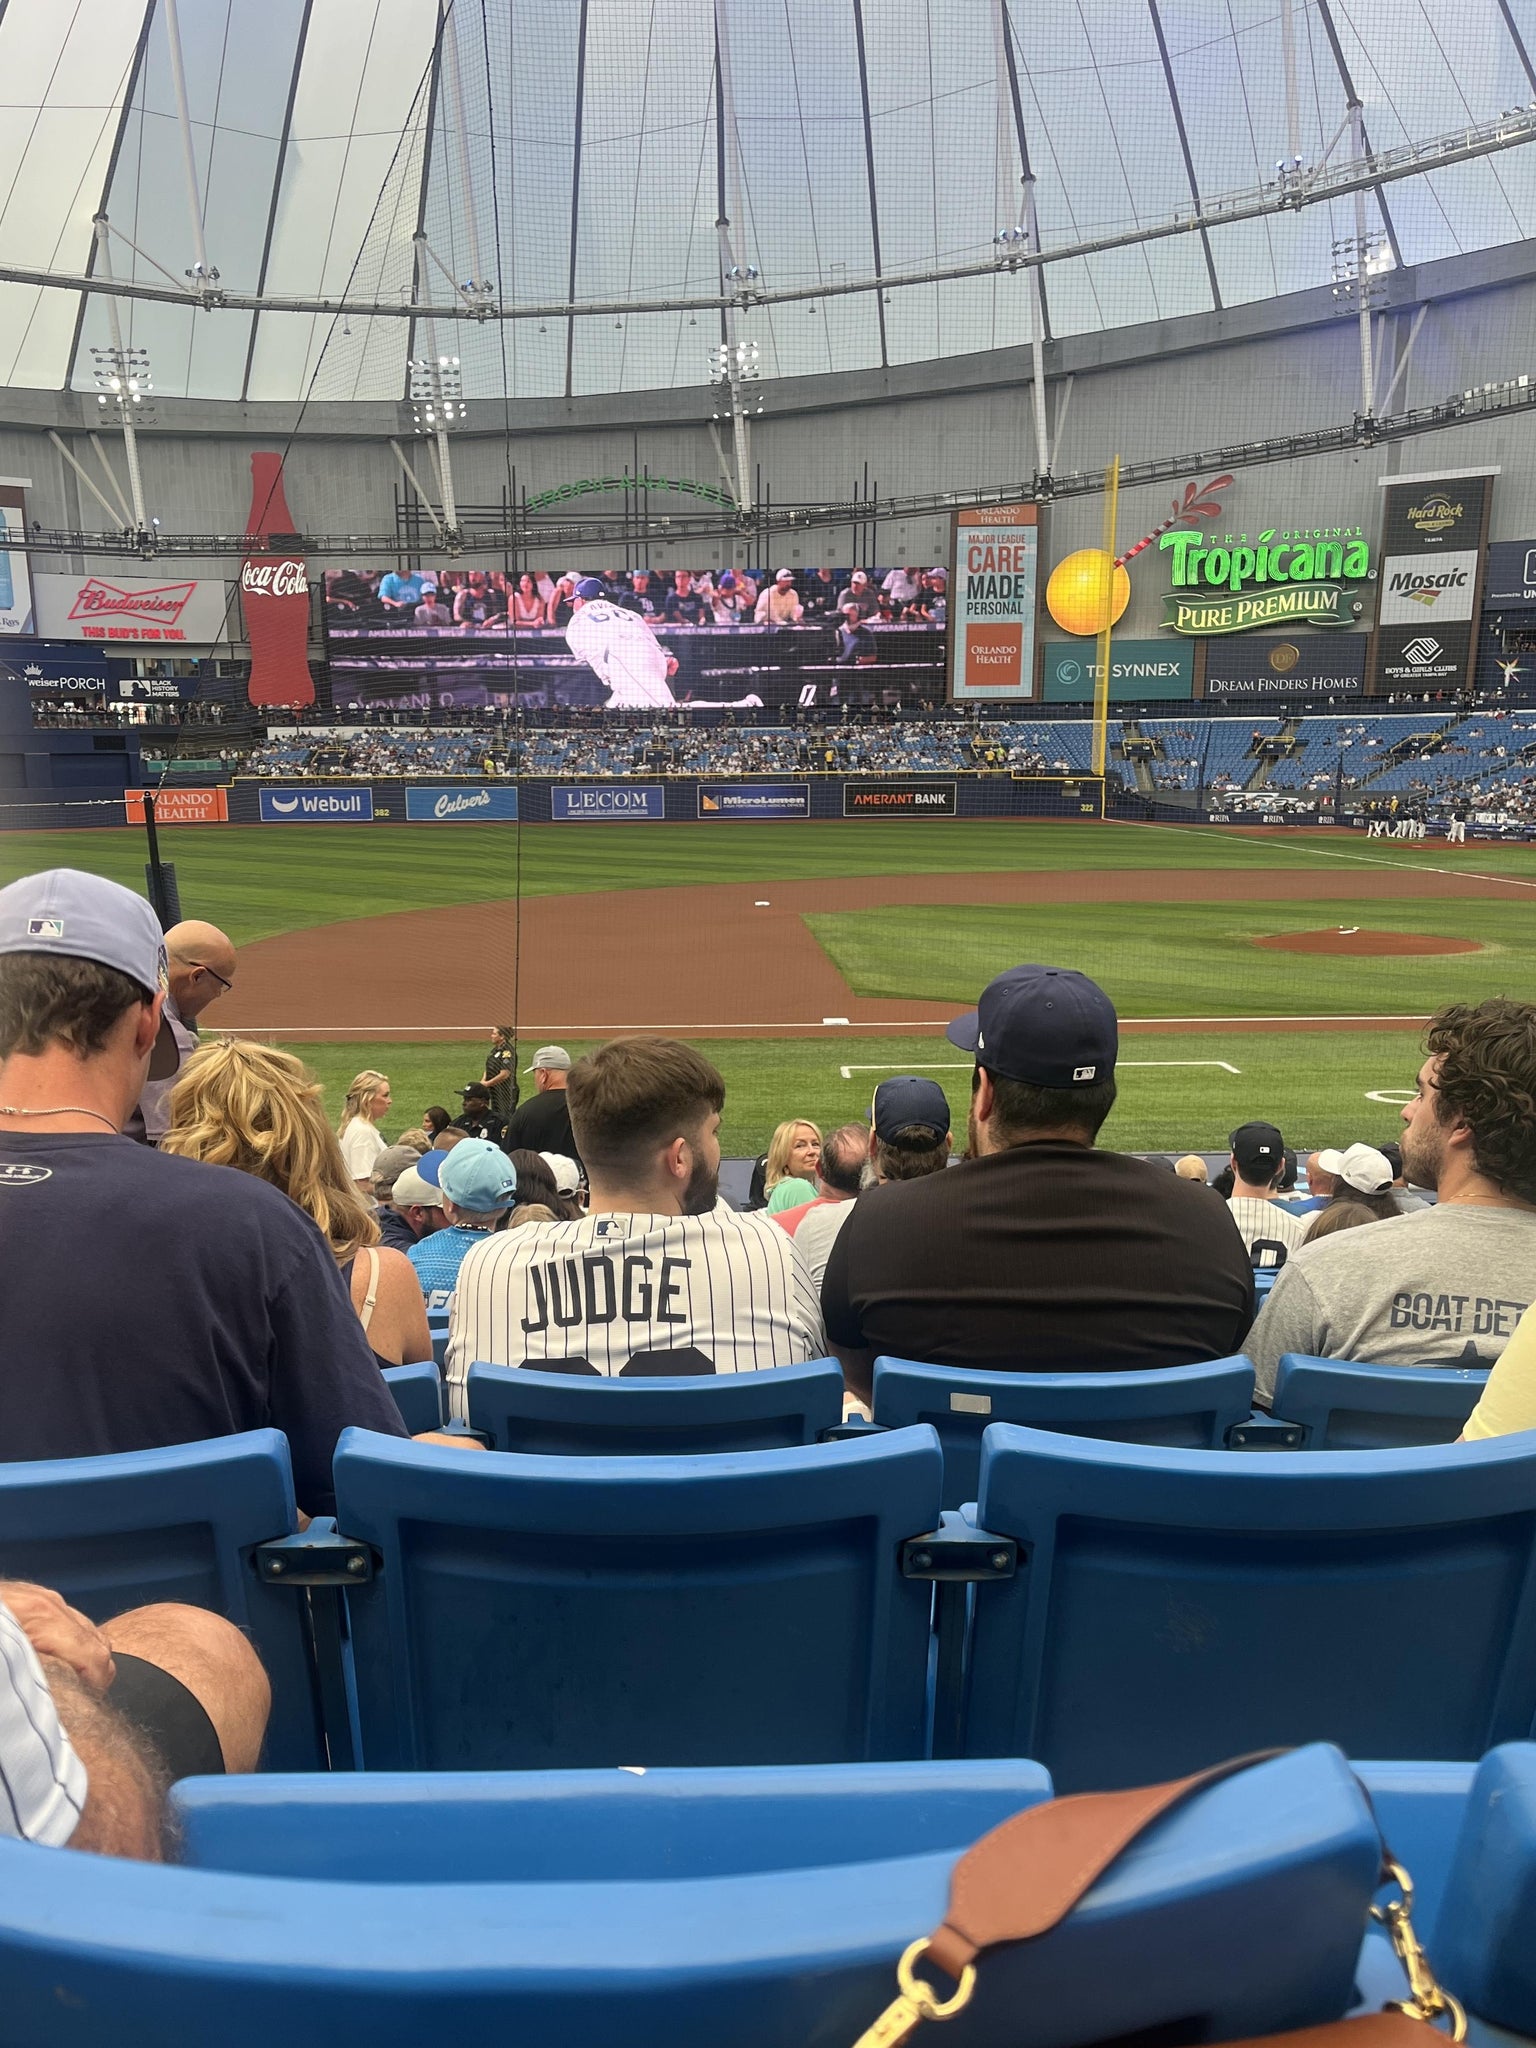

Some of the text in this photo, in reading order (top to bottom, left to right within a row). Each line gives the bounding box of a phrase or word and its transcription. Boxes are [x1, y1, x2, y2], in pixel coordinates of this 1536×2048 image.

[1407, 503, 1463, 519] Hard Rock
[981, 515, 1015, 524] HEALTH
[968, 534, 1026, 544] MAJOR LEAGUE
[1210, 527, 1363, 543] THE ORIGINAL
[967, 546, 1026, 574] CARE
[1159, 530, 1370, 591] Tropicana
[242, 561, 309, 596] Coca-Cola
[1389, 568, 1468, 591] Mosaic
[967, 575, 1025, 600] MADE
[78, 589, 184, 611] Budweiser
[966, 601, 1024, 615] PERSONAL
[1176, 590, 1339, 628] PURE PREMIUM
[82, 626, 187, 640] THIS BUD'S FOR YOU.
[971, 645, 1016, 655] ORLANDO
[976, 655, 1012, 664] HEALTH
[1112, 663, 1180, 677] SYNNEX
[60, 677, 105, 690] PORCH
[1210, 677, 1358, 693] DREAM FINDERS HOMES
[302, 795, 360, 812] Webull
[434, 789, 491, 818] Culver's
[723, 796, 805, 804] MicroLumen
[854, 793, 946, 805] AMERANT BANK
[154, 807, 206, 819] HEALTH
[374, 809, 390, 817] 382
[1080, 803, 1094, 812] 322
[520, 1255, 692, 1333] JUDGE
[1390, 1292, 1470, 1332] BOAT
